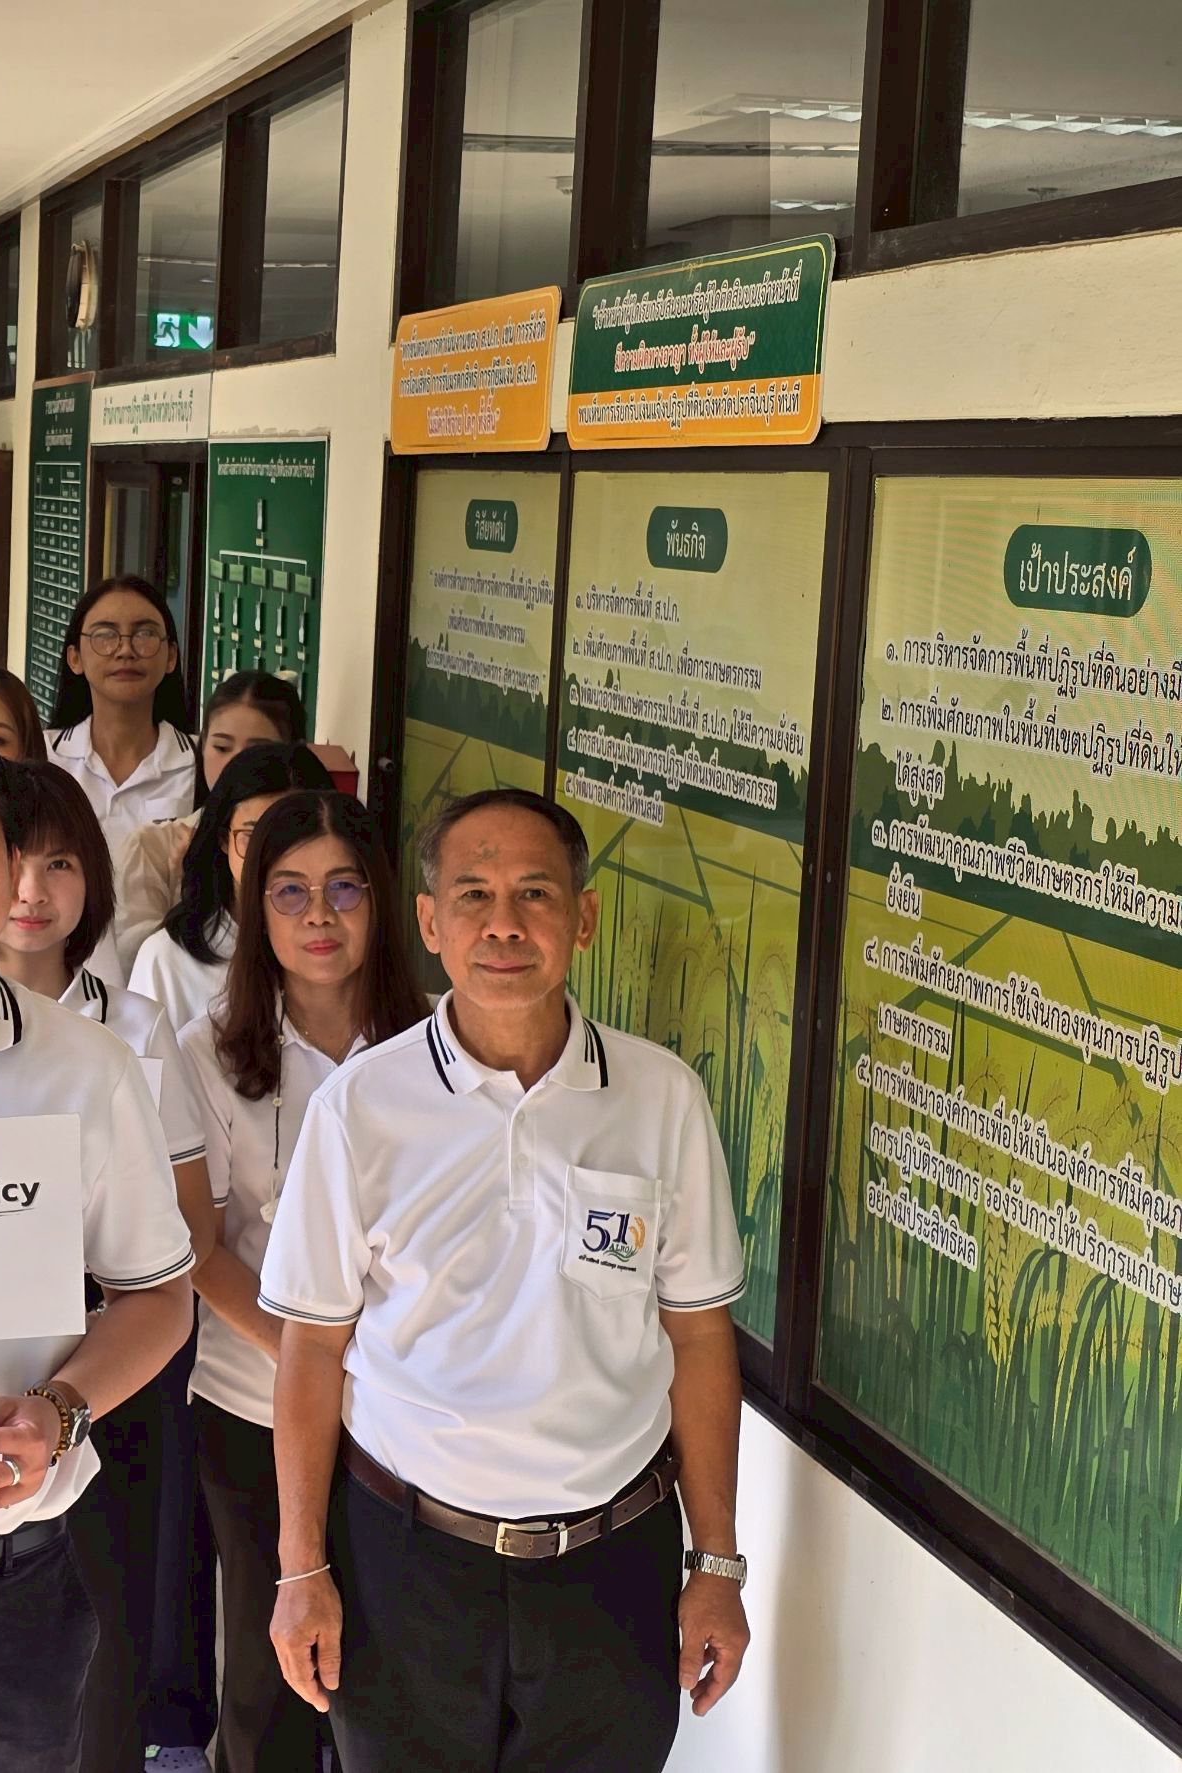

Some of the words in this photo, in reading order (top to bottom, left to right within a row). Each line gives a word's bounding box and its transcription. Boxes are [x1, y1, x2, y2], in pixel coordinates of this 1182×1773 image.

[777, 380, 801, 415] ทันที
[474, 510, 508, 543] วิสัยทัศน์
[666, 519, 706, 560] พันธกิจ
[1020, 542, 1137, 601] เป้าประสงค์
[586, 580, 653, 618] บริหารจัดการพื้นที่
[655, 596, 680, 622] ส.ป.ก.
[583, 626, 647, 668] เพิ่มศักยภาพพื้นที่
[649, 646, 674, 673] ส.ป.ก.
[676, 640, 762, 690] เพื่อการเกษตรกรรม
[886, 643, 898, 662] ๑.
[881, 698, 894, 722] ๒.
[701, 709, 729, 737] ส.ป.ก.
[732, 708, 804, 756] ให้มีความยั่งยืน
[896, 749, 943, 804] ได้สูงสุด
[874, 825, 886, 844] ๓.
[887, 867, 921, 916] ยั่งยืน
[865, 941, 878, 964] ๔.
[879, 1004, 951, 1056] เกษตรกรรม
[857, 1057, 870, 1084] ๕.
[872, 1126, 980, 1200] การปฏิบัติราชการ
[582, 1209, 630, 1252] 51
[868, 1182, 977, 1266] อย่างมีประสิทธิผล
